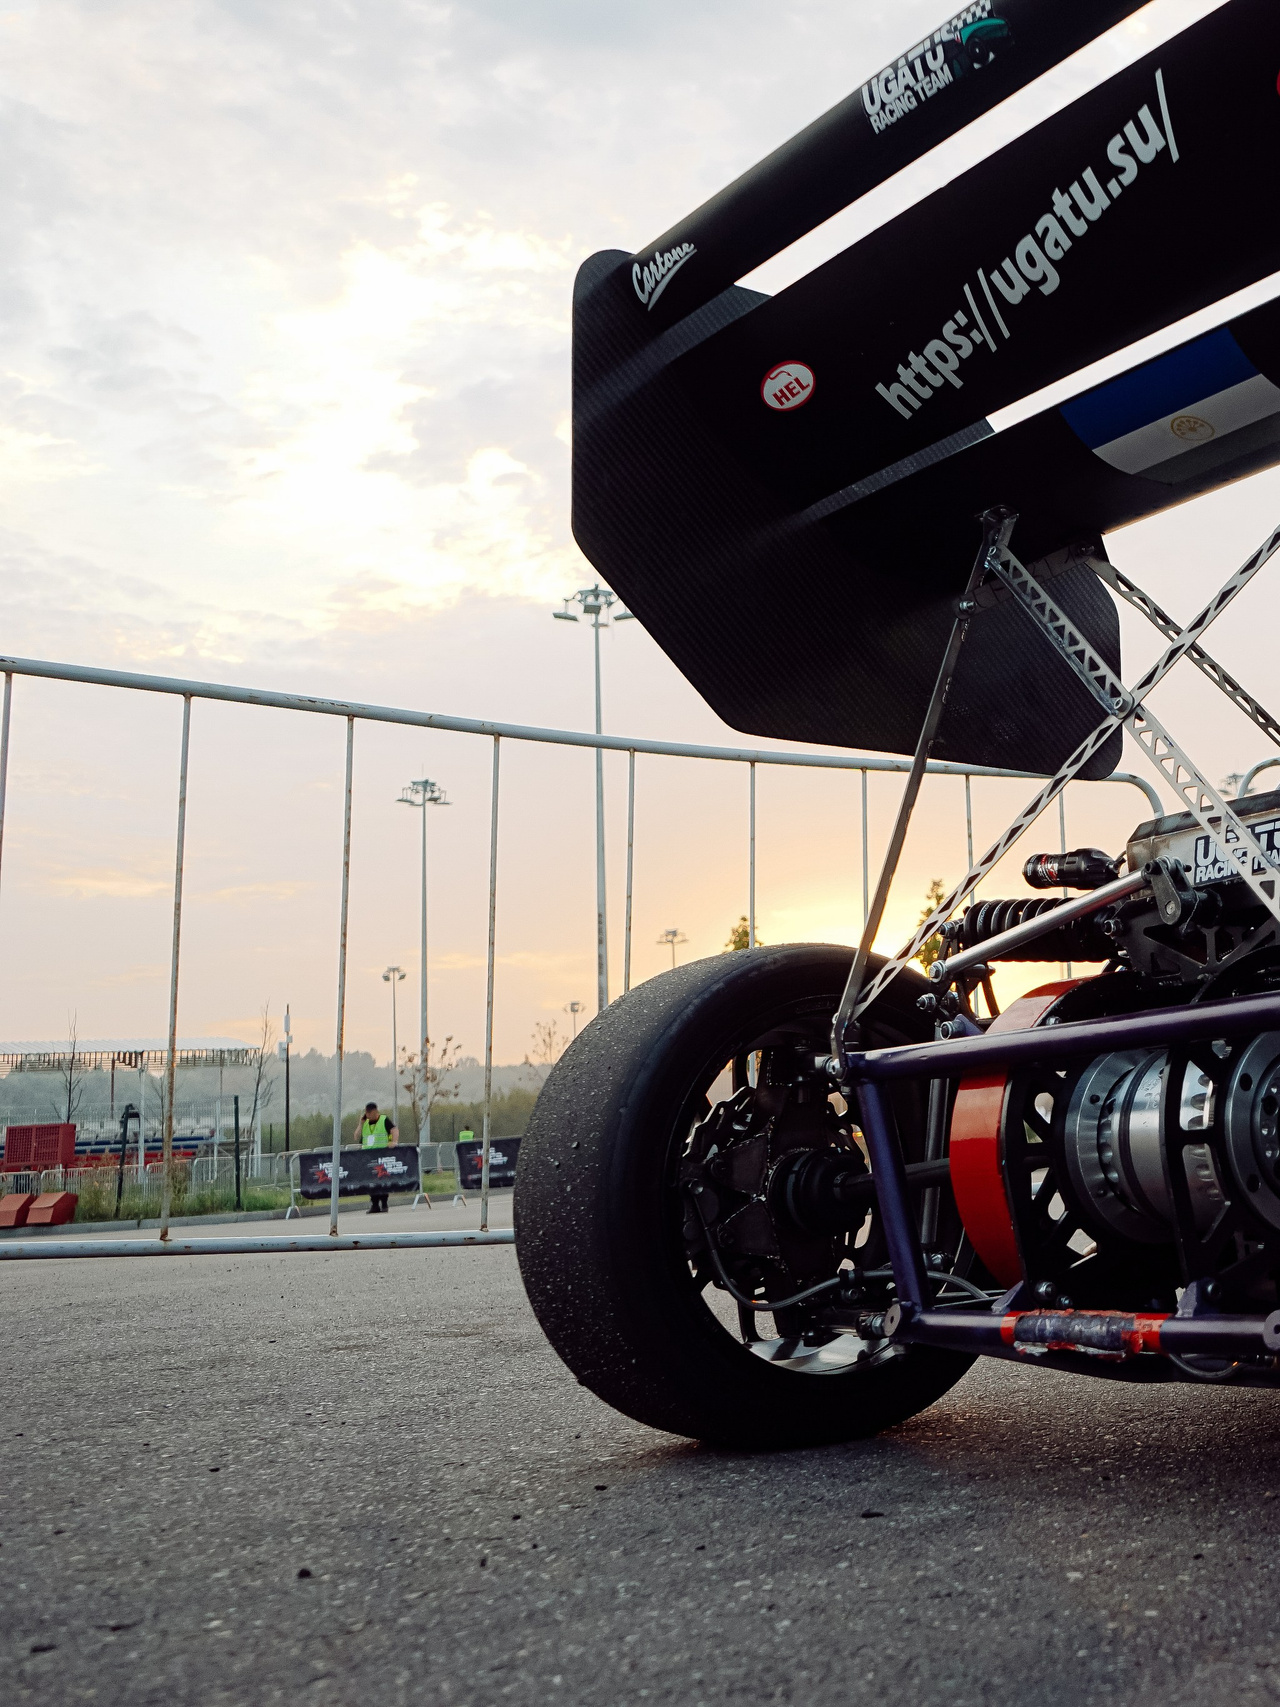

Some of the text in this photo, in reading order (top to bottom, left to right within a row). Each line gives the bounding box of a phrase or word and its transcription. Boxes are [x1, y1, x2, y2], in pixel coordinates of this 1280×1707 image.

[869, 63, 954, 135] RACING TEAM
[874, 67, 1180, 420] https://ugatu.su/
[772, 376, 811, 407] HEL
